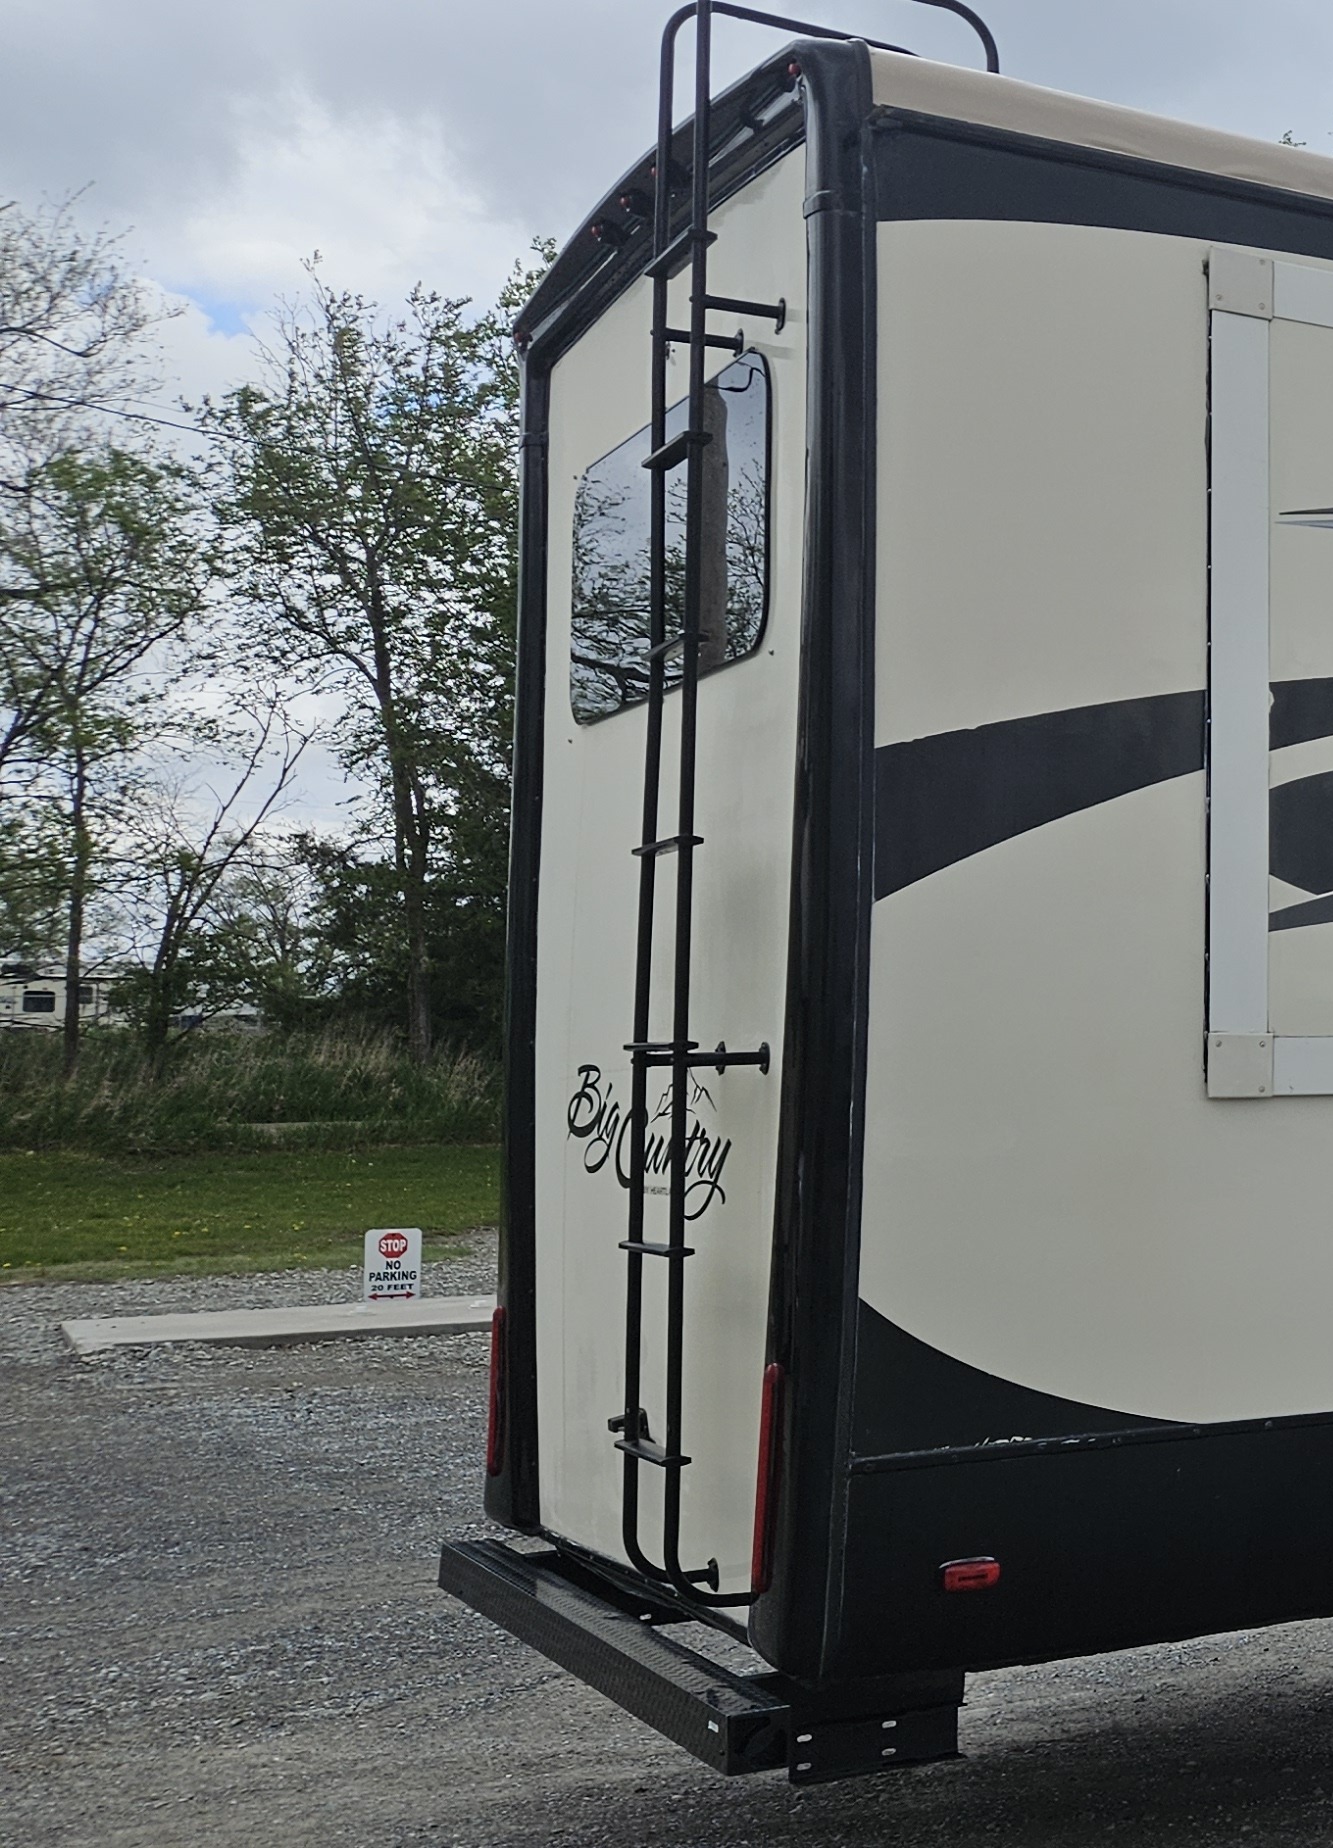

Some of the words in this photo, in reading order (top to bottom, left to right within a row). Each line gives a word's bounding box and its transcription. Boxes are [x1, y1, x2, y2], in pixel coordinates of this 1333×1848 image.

[567, 1064, 621, 1173] Big
[380, 1239, 407, 1252] STOP
[385, 1260, 401, 1270] NO
[368, 1271, 417, 1282] PARKING
[387, 1283, 414, 1291] FEET
